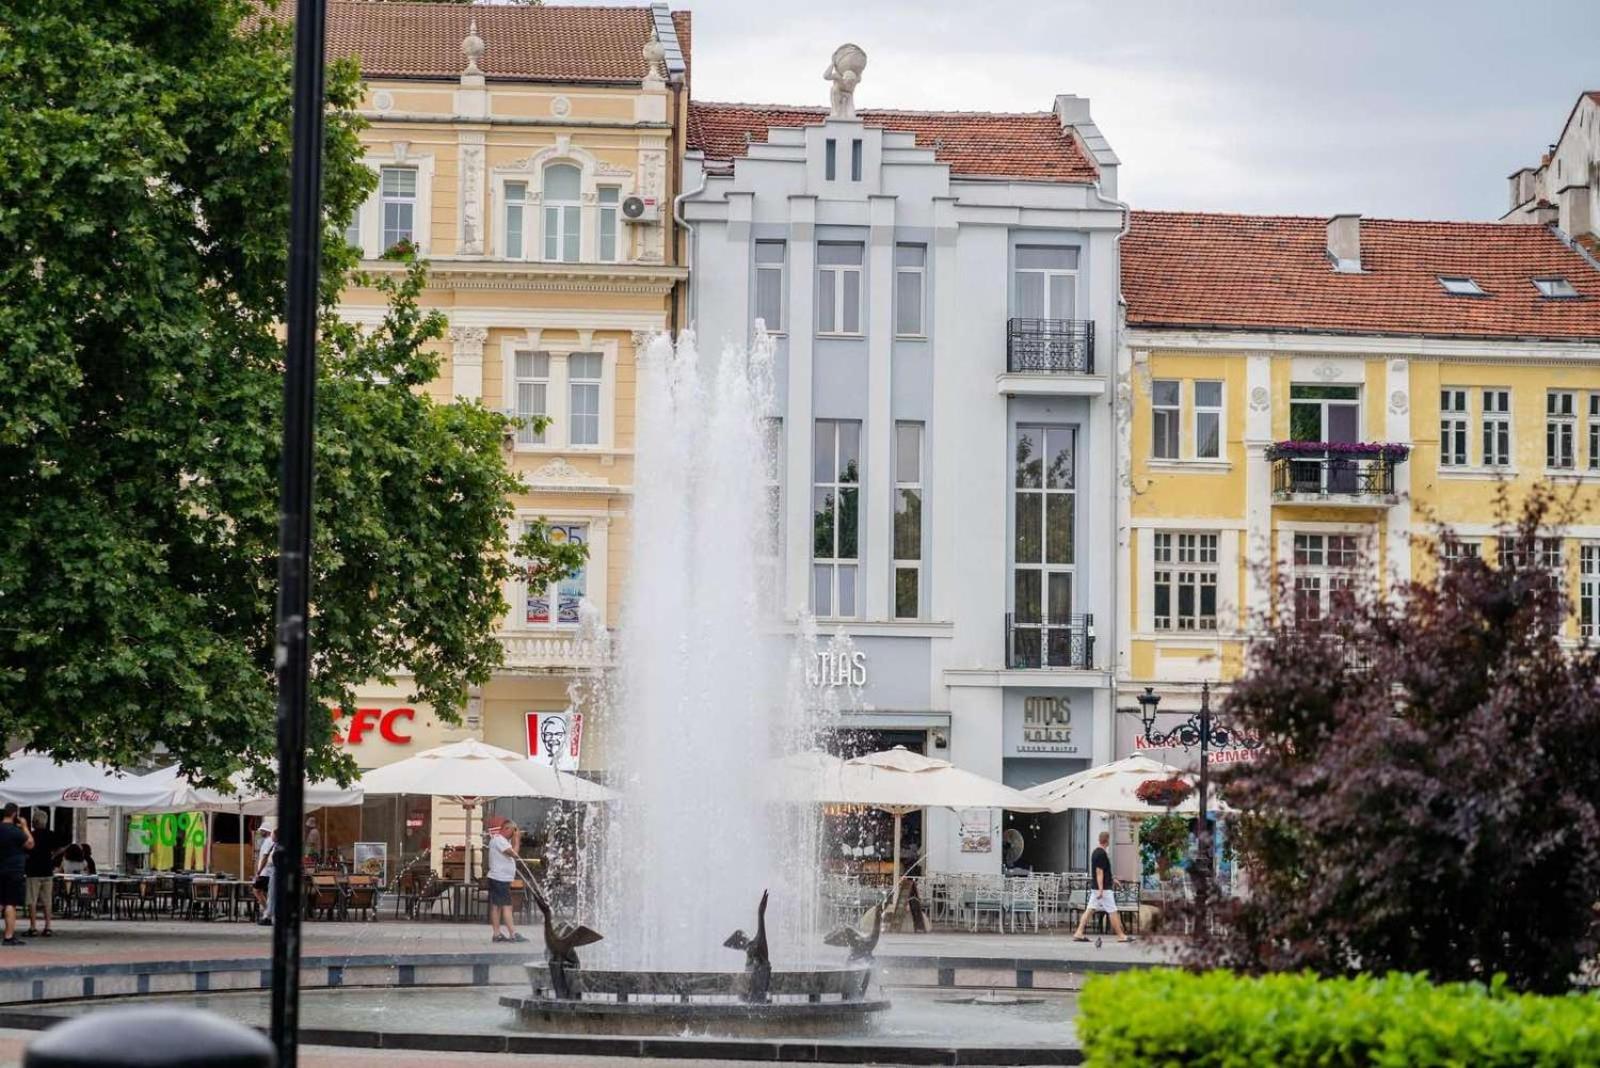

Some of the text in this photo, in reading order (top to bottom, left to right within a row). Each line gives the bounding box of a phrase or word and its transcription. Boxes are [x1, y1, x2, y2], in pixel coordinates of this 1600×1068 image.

[1024, 696, 1071, 724] ATLAS
[1024, 731, 1071, 742] HOUSE
[128, 813, 205, 847] -50%
